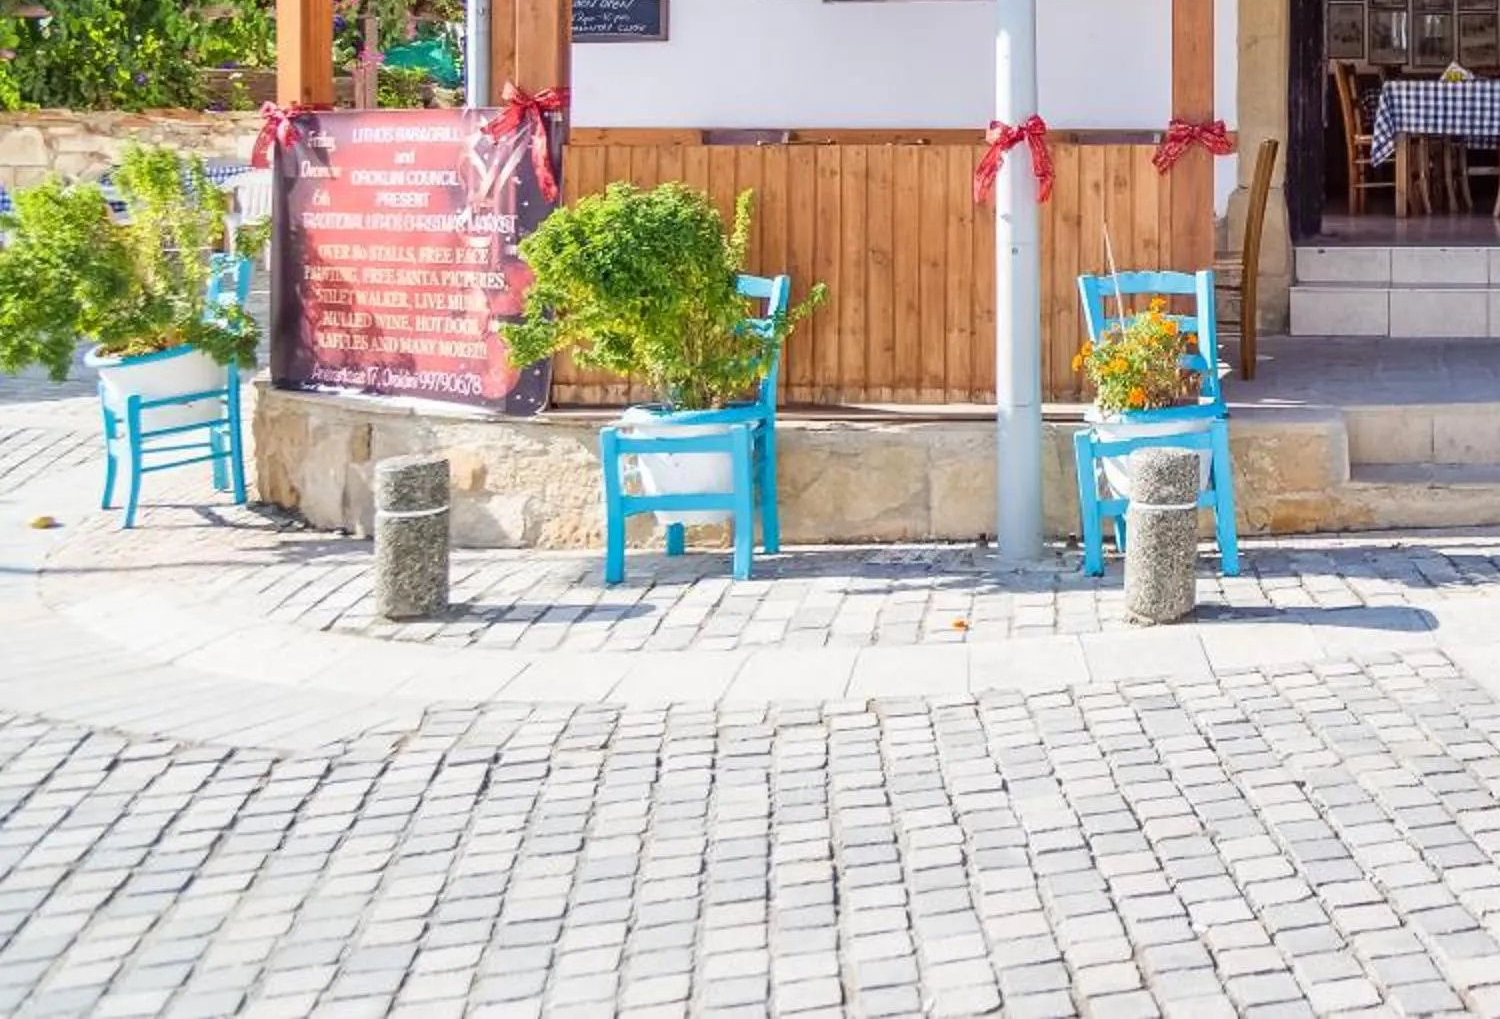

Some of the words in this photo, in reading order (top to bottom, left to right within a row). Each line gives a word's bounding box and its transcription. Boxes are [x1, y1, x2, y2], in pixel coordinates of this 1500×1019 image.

[405, 170, 460, 187] COUNCIL
[318, 244, 350, 260] OVER
[418, 246, 453, 263] FREE
[456, 247, 489, 264] FACE
[363, 267, 397, 285] FREE
[397, 269, 439, 286] SANTA
[414, 292, 449, 309] LIVE
[415, 315, 440, 332] HOT
[369, 335, 399, 352] AND
[399, 338, 438, 355] MANY
